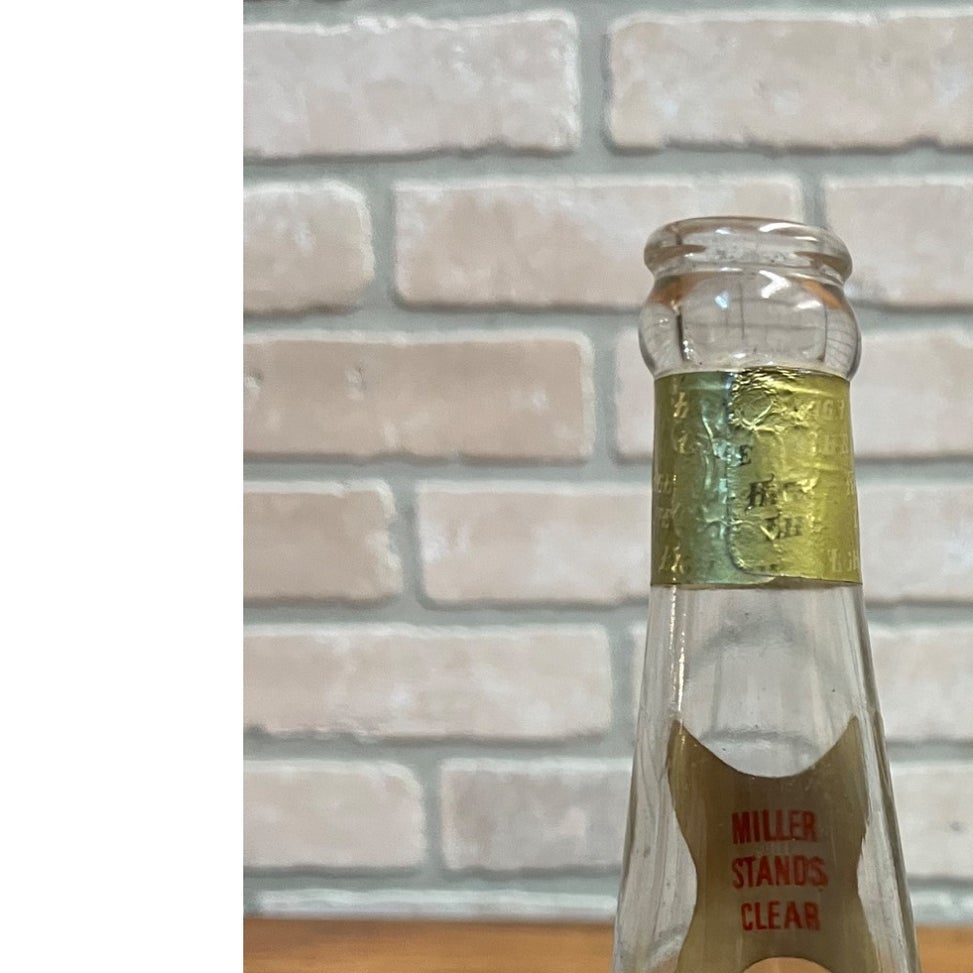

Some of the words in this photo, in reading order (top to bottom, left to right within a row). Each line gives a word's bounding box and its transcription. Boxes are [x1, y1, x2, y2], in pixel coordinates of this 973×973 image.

[732, 809, 818, 844] MILLER
[731, 855, 829, 889] STANDS
[741, 901, 821, 931] CLEAR
